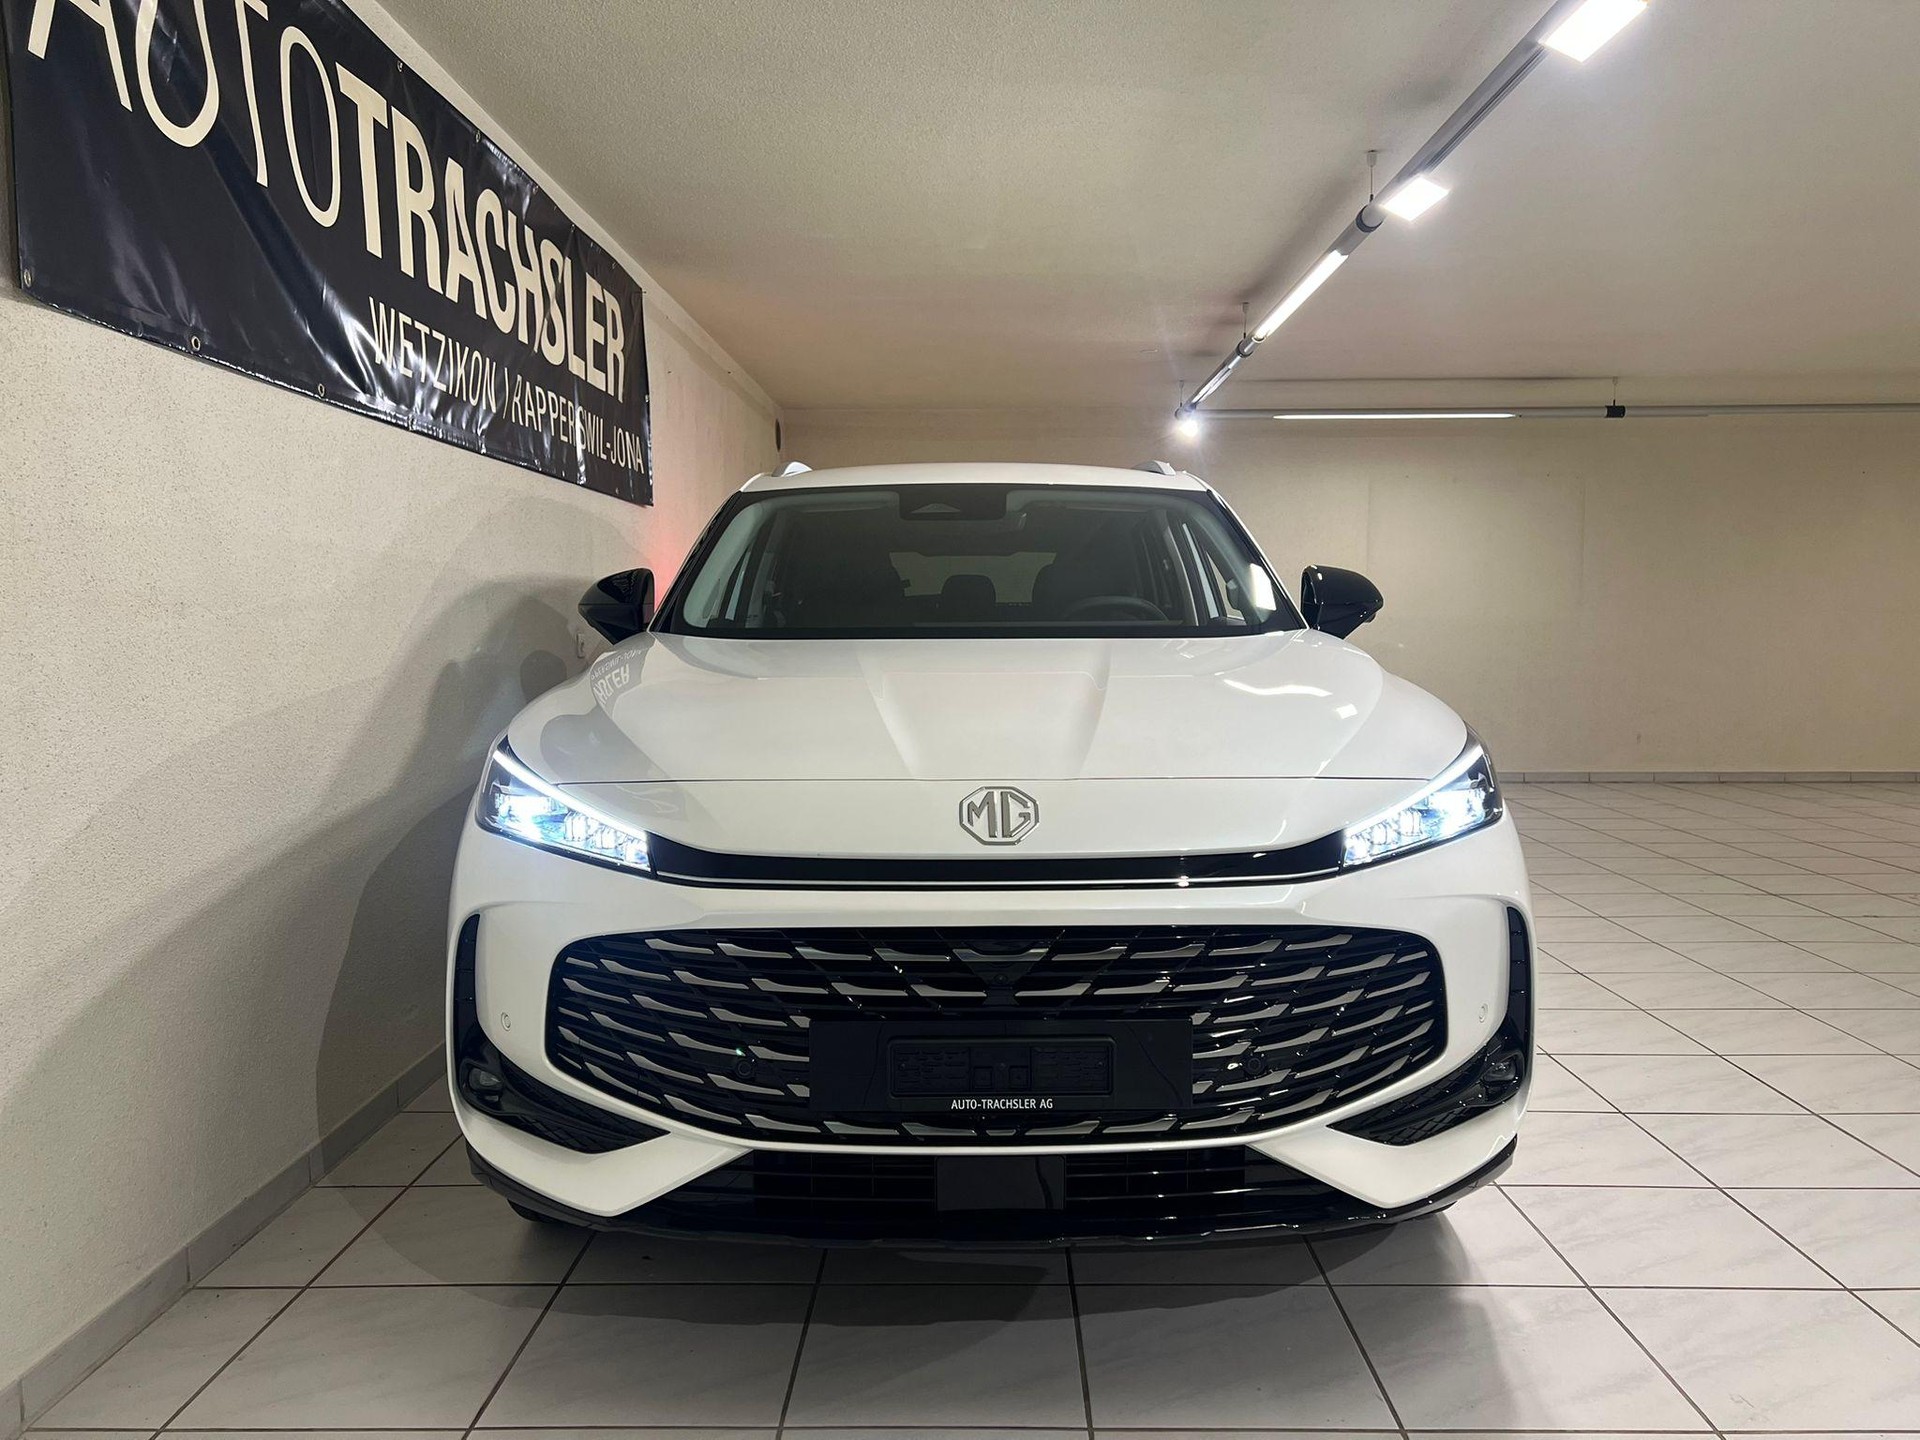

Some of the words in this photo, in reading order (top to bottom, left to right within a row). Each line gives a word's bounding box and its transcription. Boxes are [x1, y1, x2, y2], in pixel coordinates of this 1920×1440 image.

[369, 296, 496, 413] WETZIKON
[967, 790, 1031, 838] MG
[951, 1098, 1036, 1110] AUTO-TRACHSLER
[1039, 1098, 1054, 1109] AG
